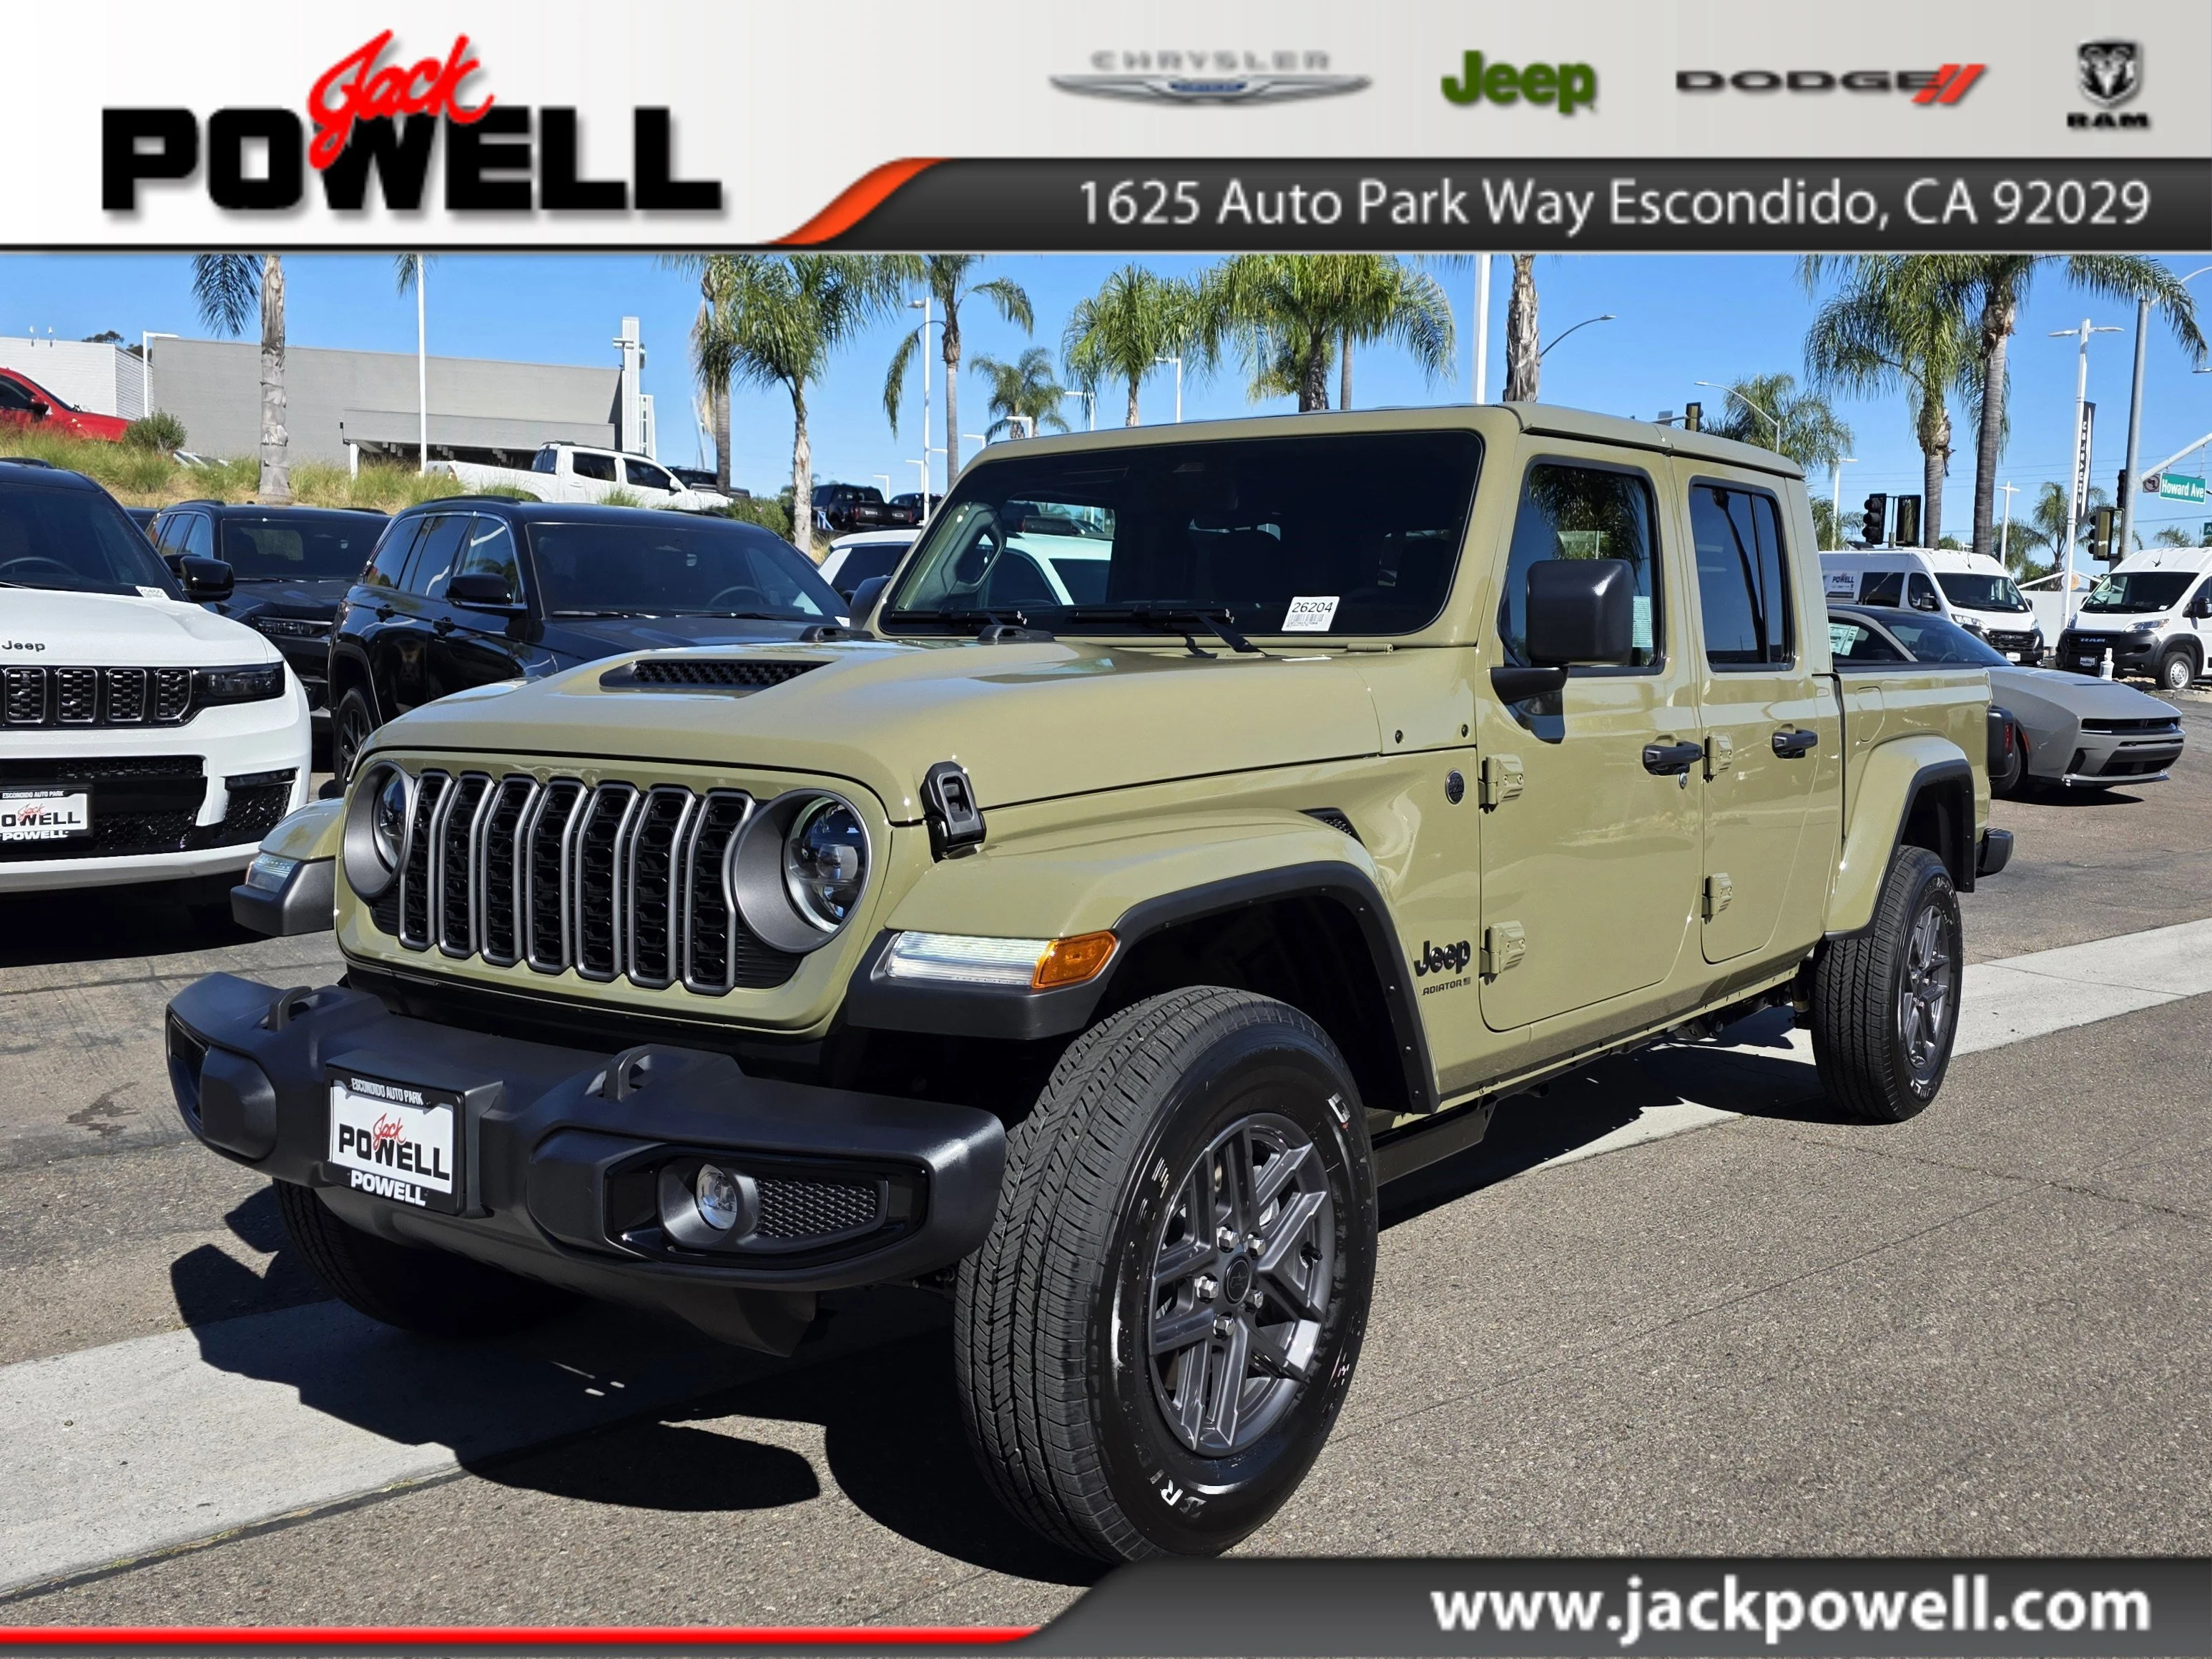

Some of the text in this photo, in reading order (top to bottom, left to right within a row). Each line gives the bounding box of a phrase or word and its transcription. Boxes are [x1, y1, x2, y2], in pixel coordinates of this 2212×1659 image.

[2161, 478, 2204, 498] Howard Ave
[1292, 601, 1333, 613] 26204
[1, 640, 46, 652] Jeep
[1, 812, 81, 827] OWELL
[17, 802, 47, 822] Jack
[2, 830, 68, 841] POWELL
[1413, 940, 1471, 978] Jeep
[1422, 978, 1463, 996] ADIATOR
[350, 1077, 423, 1106] ESCONDIDO AUTO PARK
[373, 1112, 406, 1151] Jack
[338, 1123, 450, 1181] POWELL
[350, 1169, 426, 1206] POWELL
